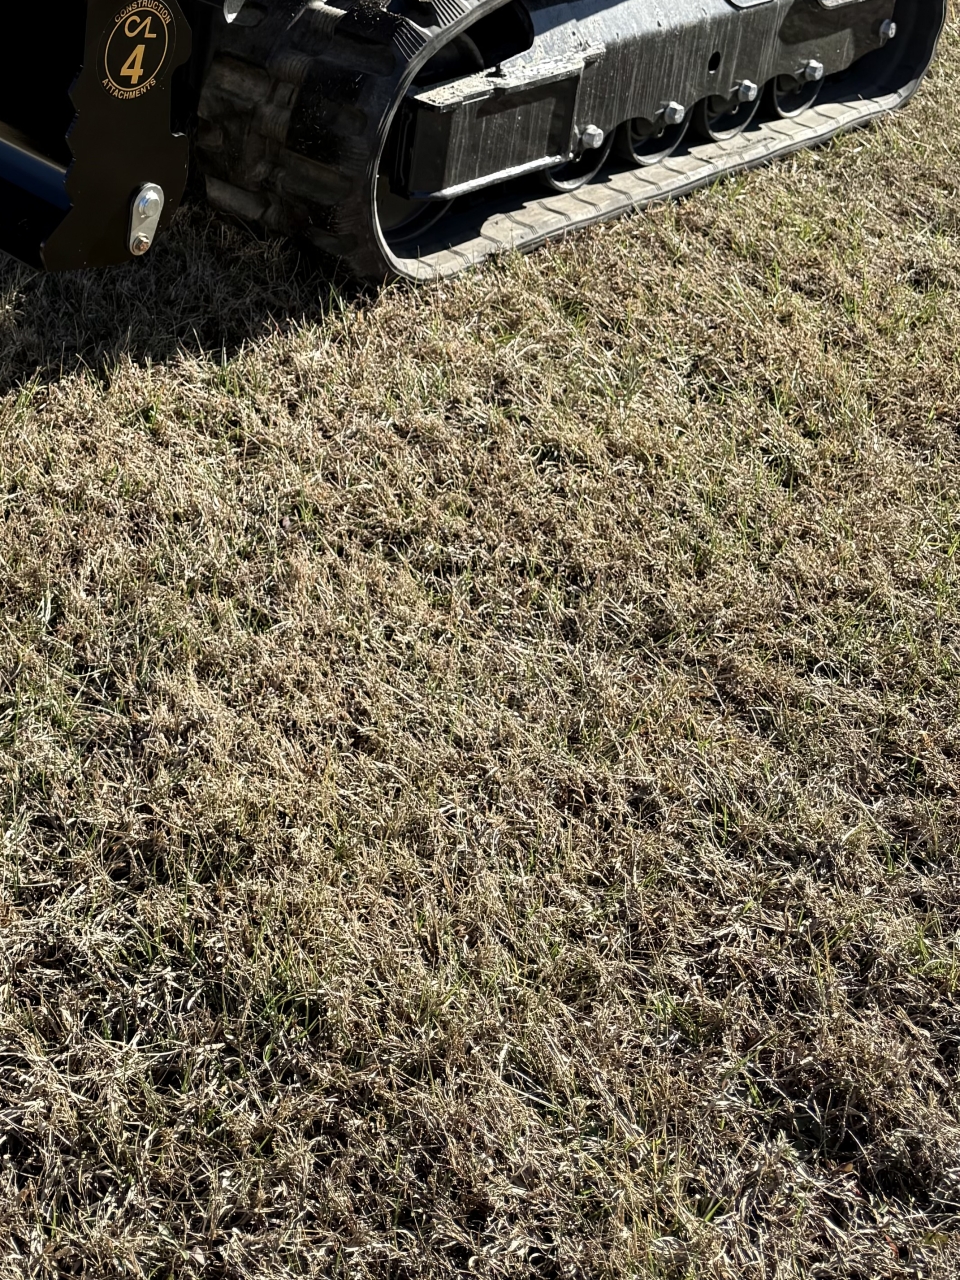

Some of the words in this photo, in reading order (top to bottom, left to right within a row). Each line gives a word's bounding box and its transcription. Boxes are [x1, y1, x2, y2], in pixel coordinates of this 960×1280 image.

[114, 0, 171, 24] CONSTRUCTION
[120, 44, 146, 84] 4
[102, 78, 157, 100] ATTACHMENTS
